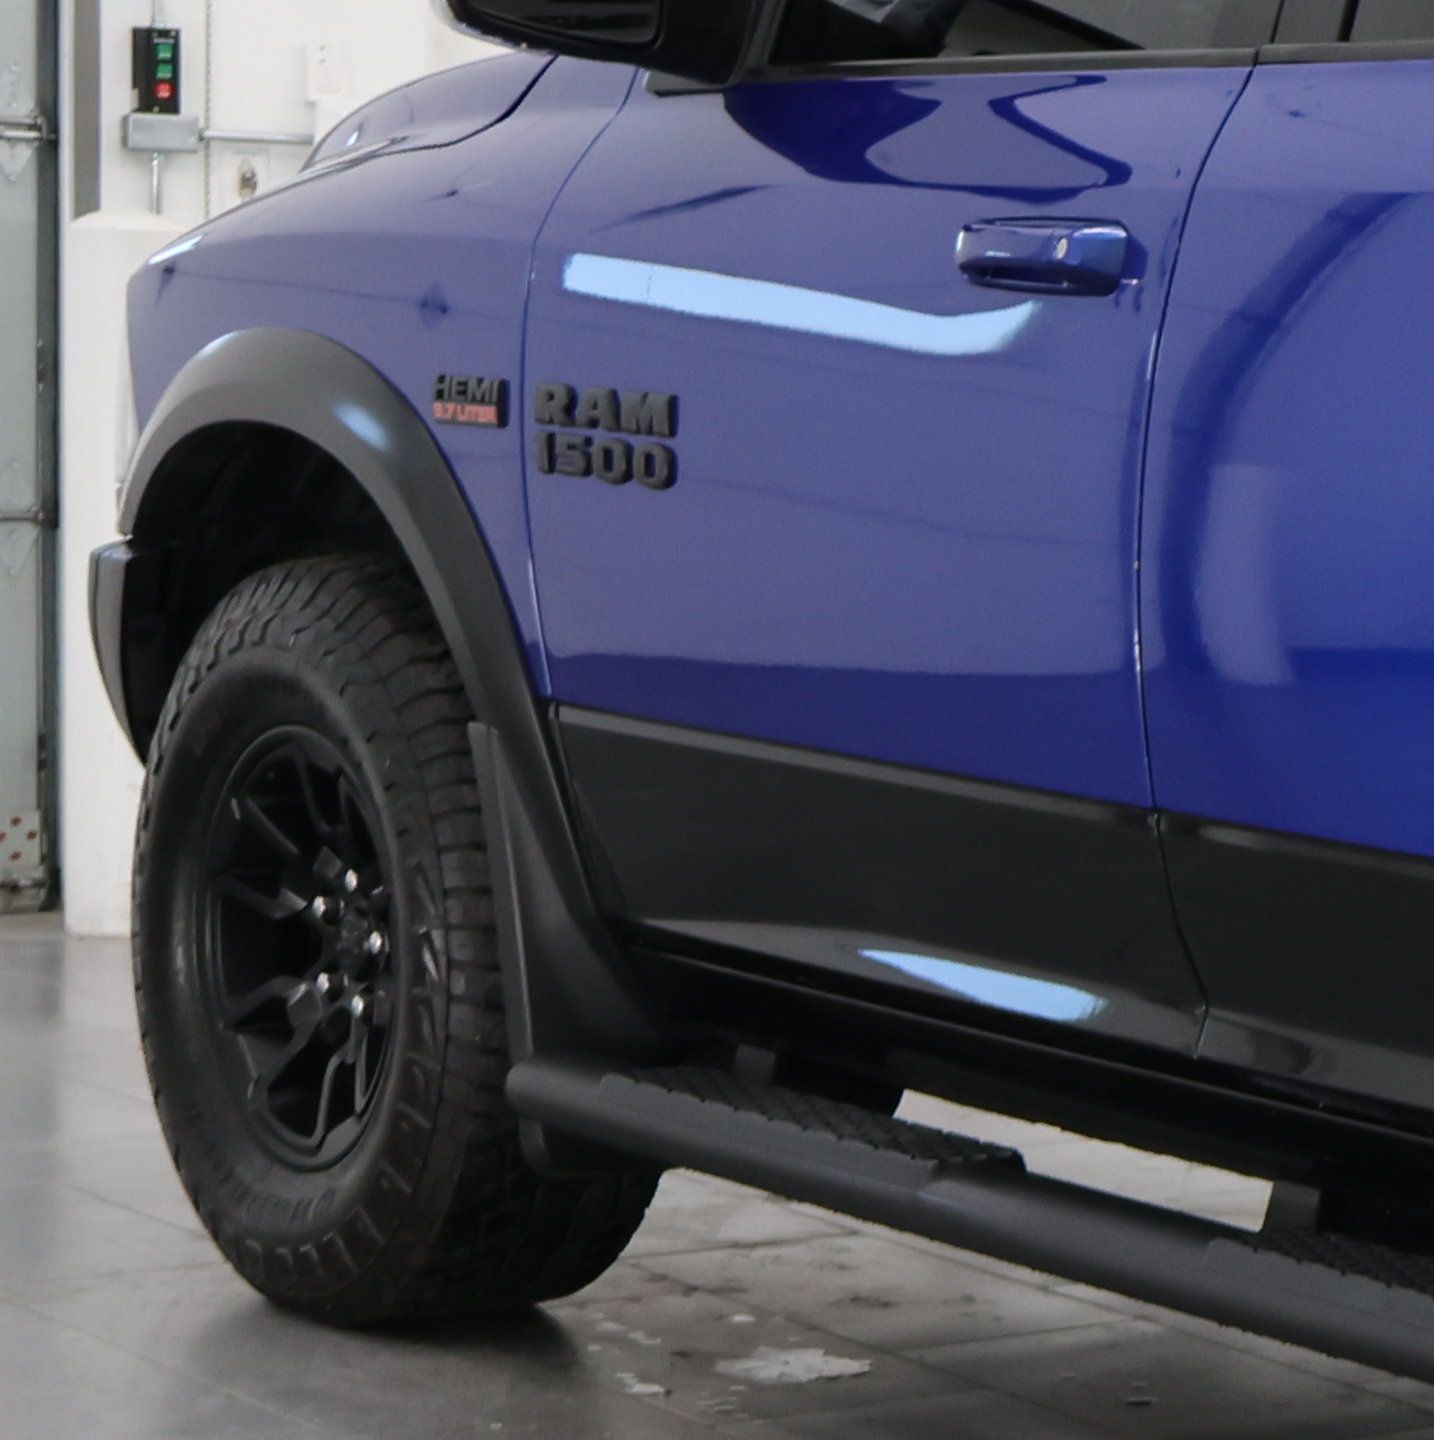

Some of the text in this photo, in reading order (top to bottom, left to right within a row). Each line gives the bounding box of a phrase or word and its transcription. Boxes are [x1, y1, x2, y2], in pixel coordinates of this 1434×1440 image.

[433, 373, 501, 403] HEMI
[534, 381, 677, 438] RAM
[536, 431, 677, 491] 1500
